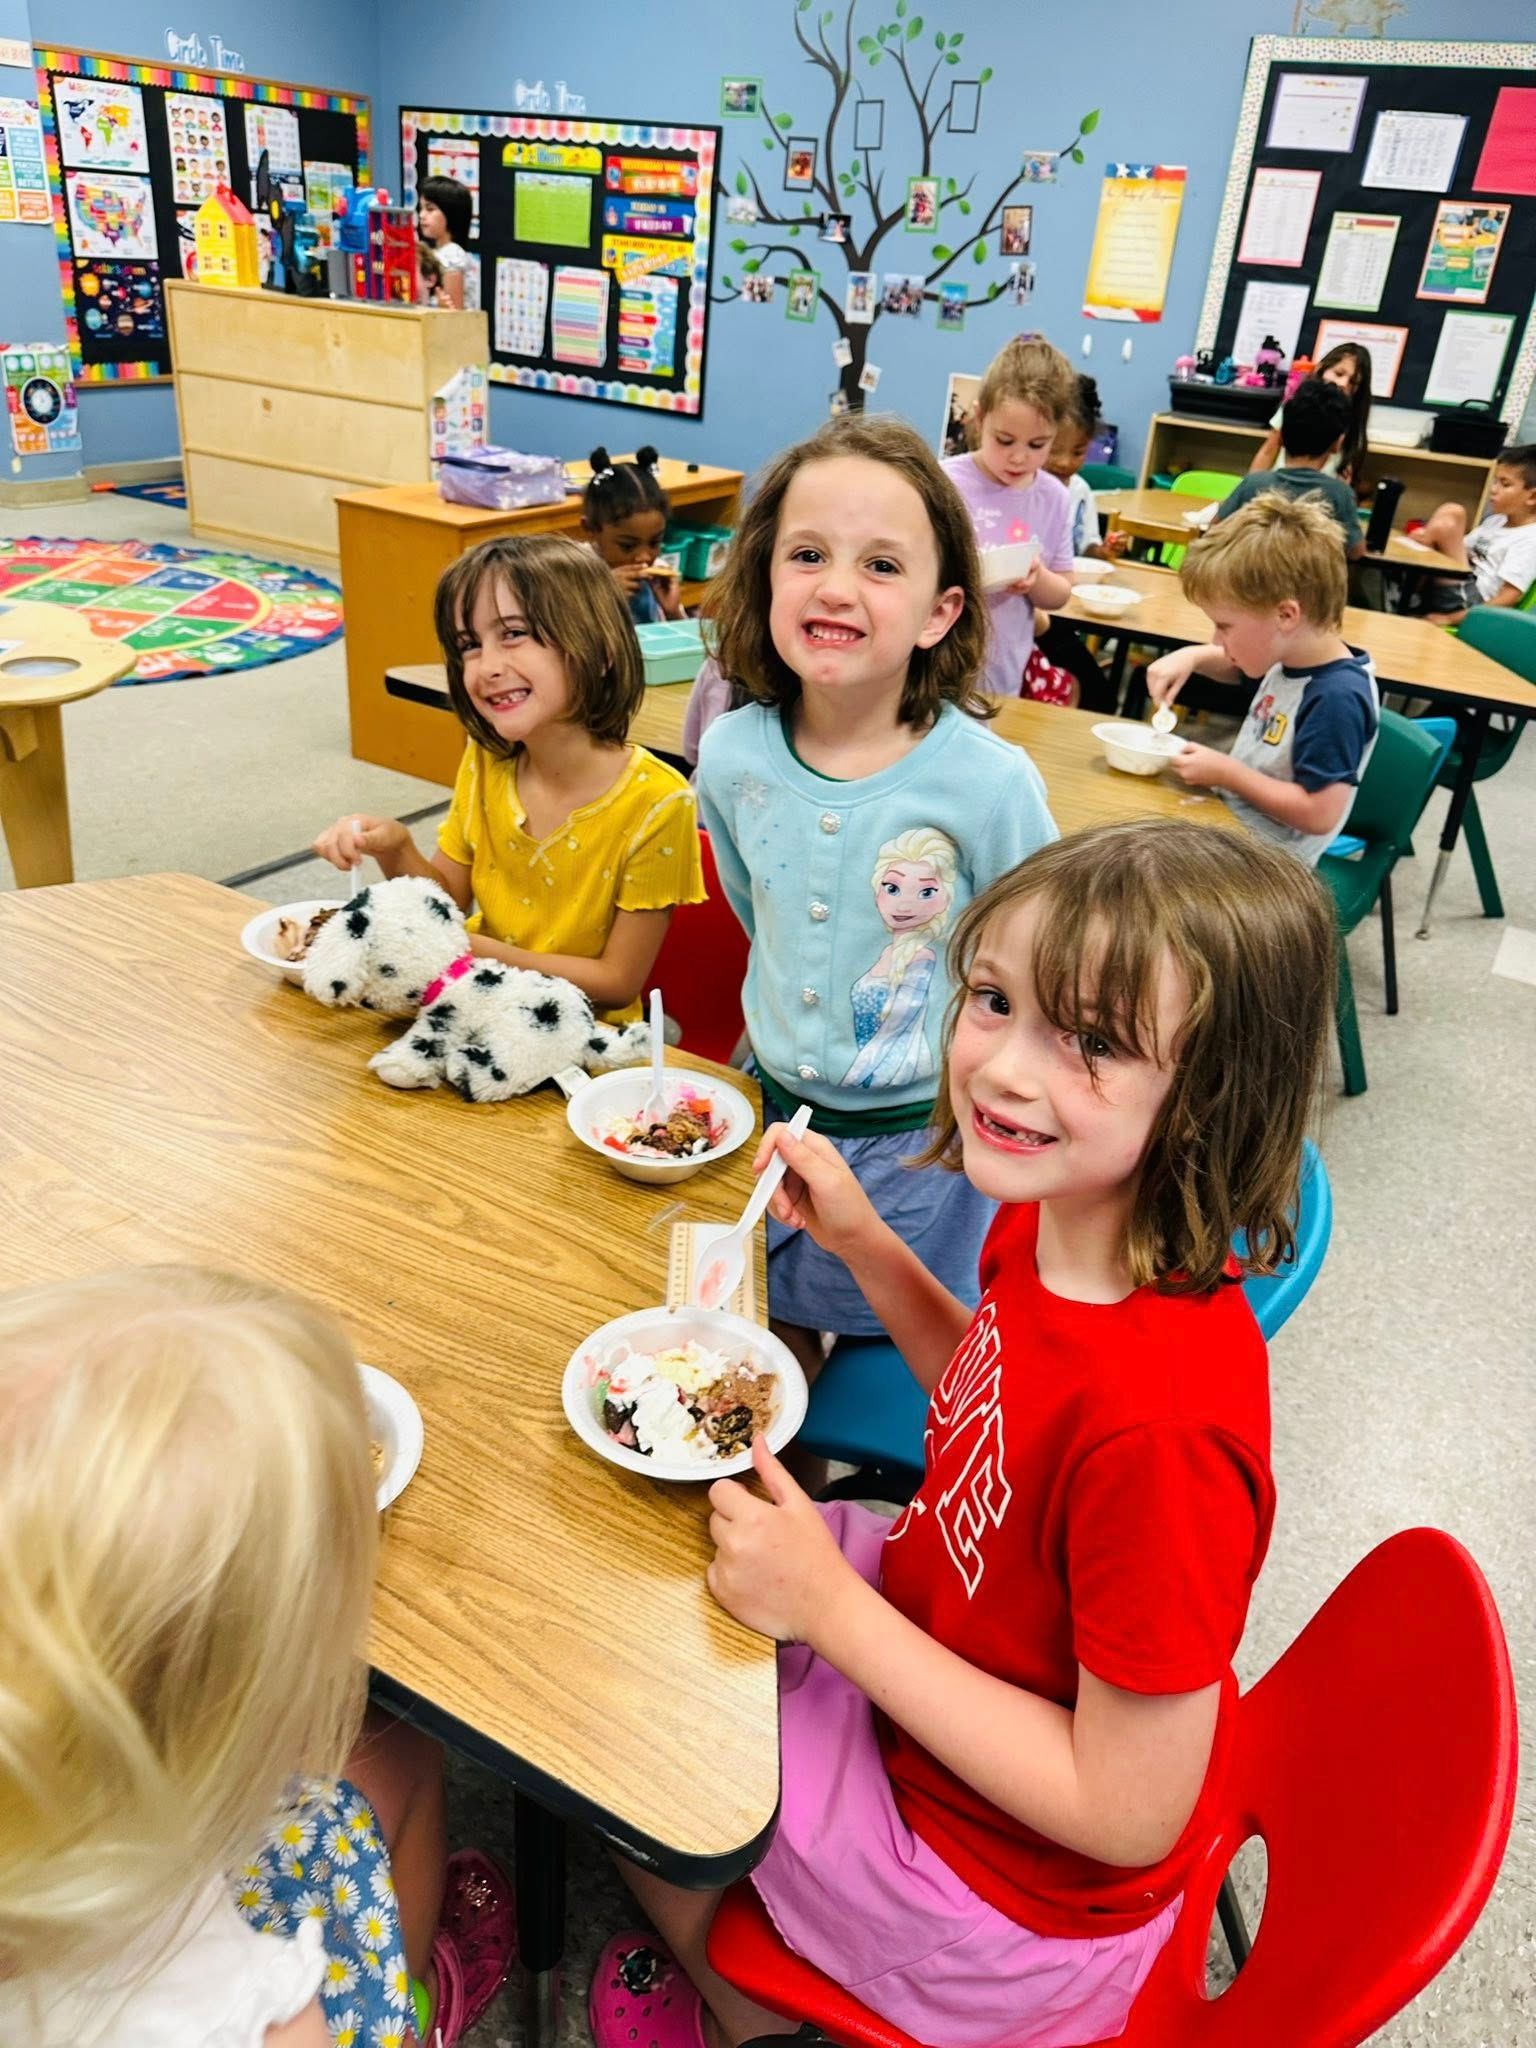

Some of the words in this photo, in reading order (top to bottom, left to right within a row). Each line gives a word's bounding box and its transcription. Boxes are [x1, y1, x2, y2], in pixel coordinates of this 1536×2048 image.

[165, 27, 208, 68] Circle
[208, 34, 245, 73] Time
[222, 602, 255, 610] 1
[174, 626, 216, 637] 2
[922, 1288, 1012, 1600] OVE
